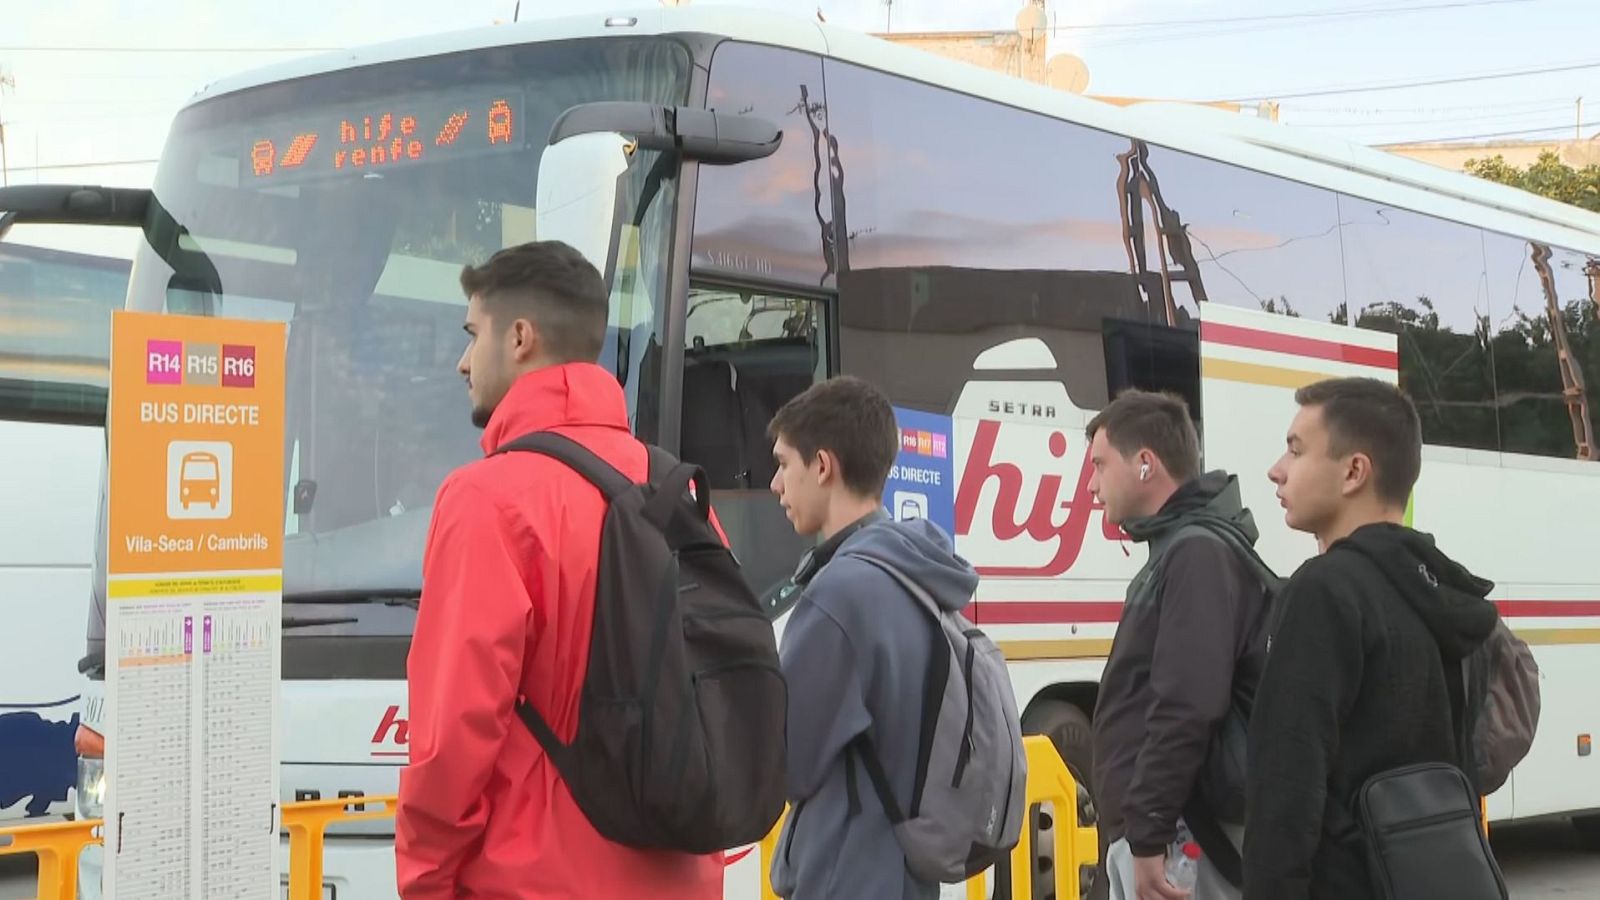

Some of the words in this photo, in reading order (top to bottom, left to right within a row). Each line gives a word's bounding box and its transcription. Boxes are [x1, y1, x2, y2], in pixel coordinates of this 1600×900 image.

[340, 113, 416, 142] hife
[334, 137, 423, 168] renfe
[149, 352, 181, 373] R14
[187, 355, 217, 375] R15
[224, 357, 254, 376] R16
[140, 402, 179, 424] BUS
[183, 404, 259, 425] DIRECTE
[988, 400, 1056, 418] SETRA
[901, 467, 941, 485] DIRECTE
[954, 419, 1133, 577] hif
[125, 534, 194, 553] Vila-Seca
[207, 532, 269, 551] Cambrils
